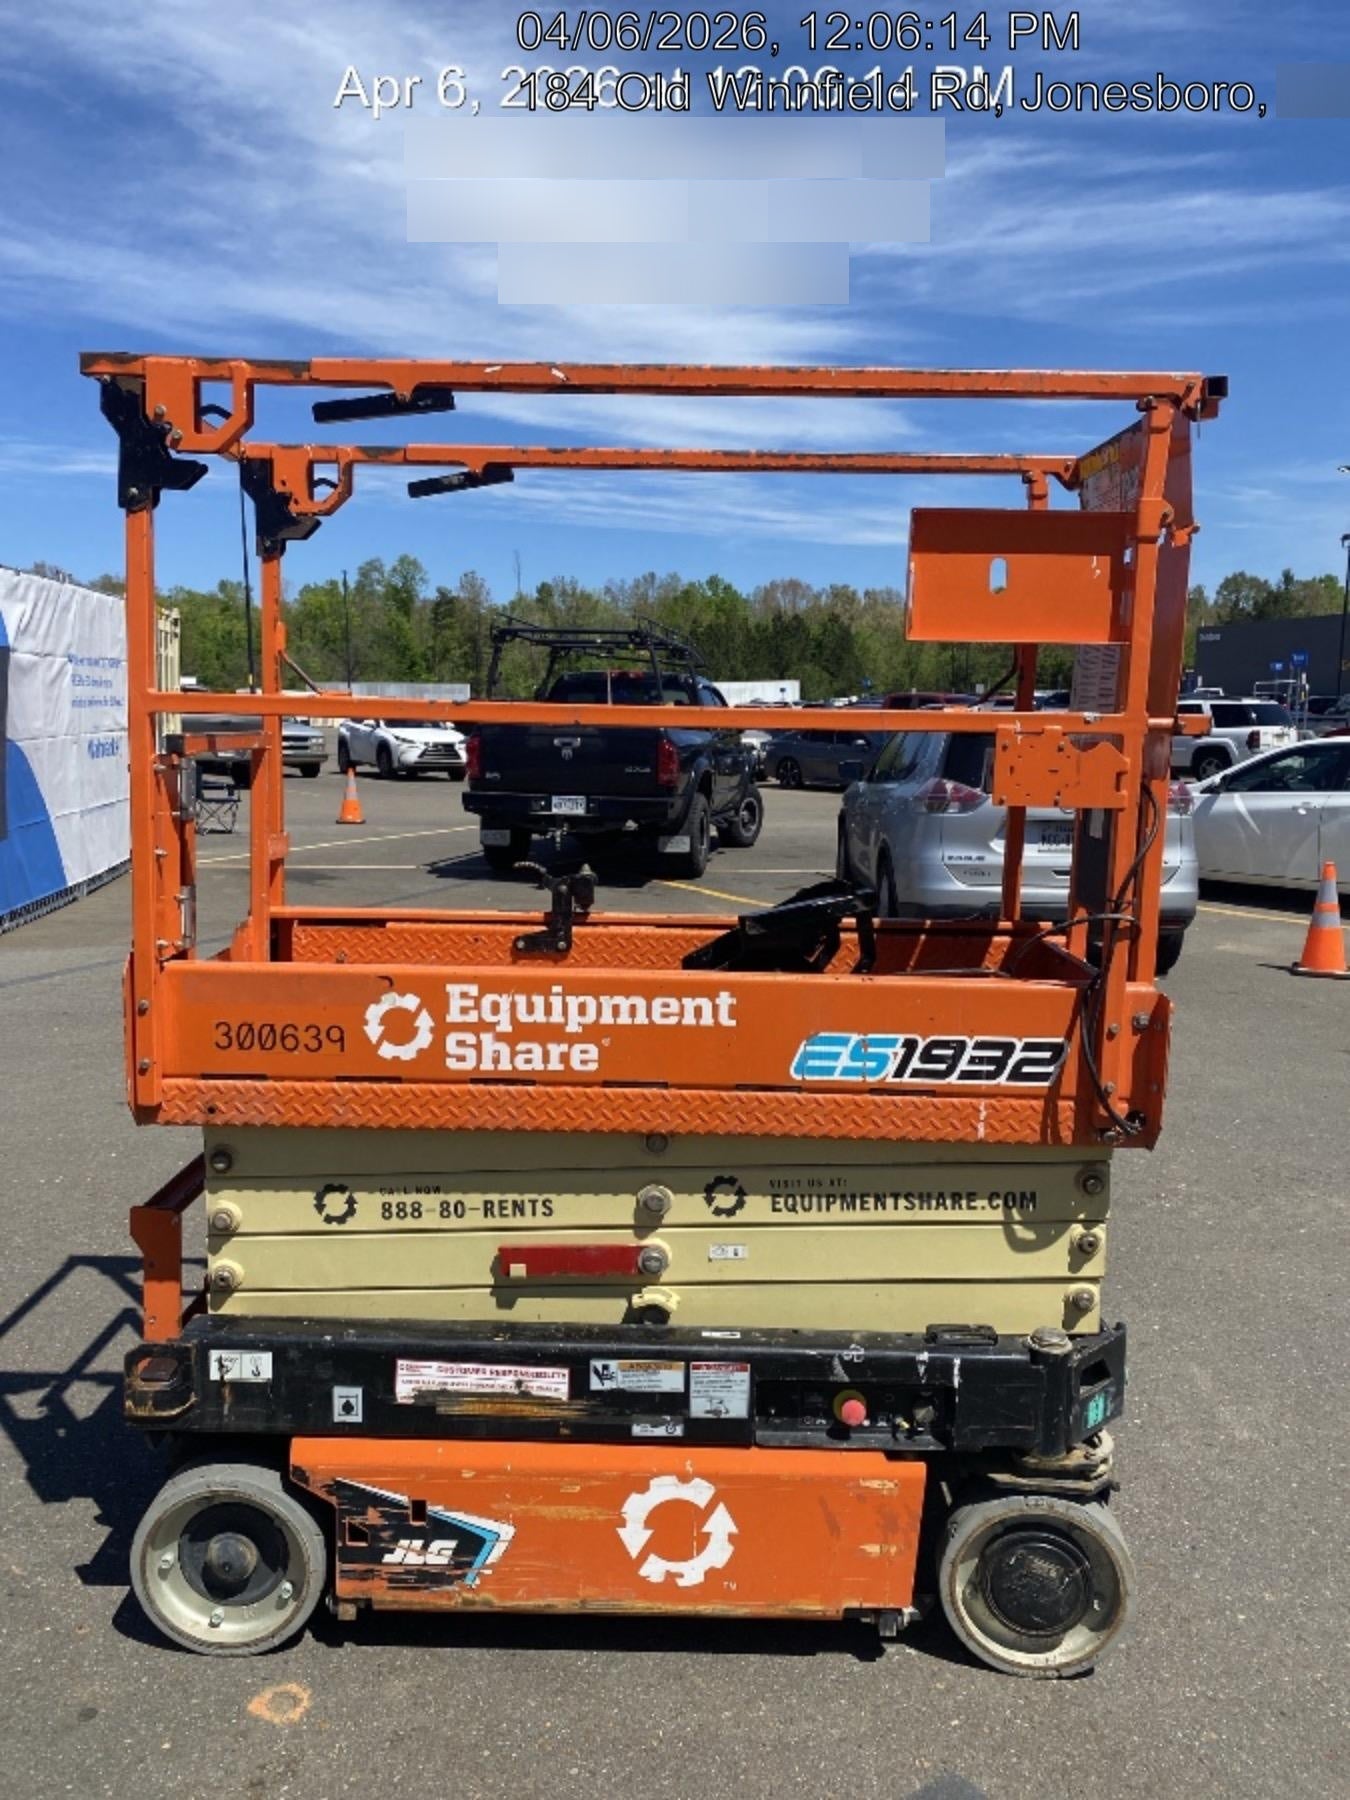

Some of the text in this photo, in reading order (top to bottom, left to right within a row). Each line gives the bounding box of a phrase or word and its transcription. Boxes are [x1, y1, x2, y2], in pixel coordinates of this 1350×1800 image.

[445, 984, 737, 1033] Equipment
[214, 1021, 346, 1053] 300639
[445, 1031, 600, 1072] Share
[791, 1033, 1068, 1085] ES1932
[379, 1186, 411, 1196] CAL
[771, 1191, 1037, 1214] EQUIPMENTSHARE.COM
[381, 1199, 554, 1220] 888-80-RENTS
[382, 1539, 458, 1564] JLG
